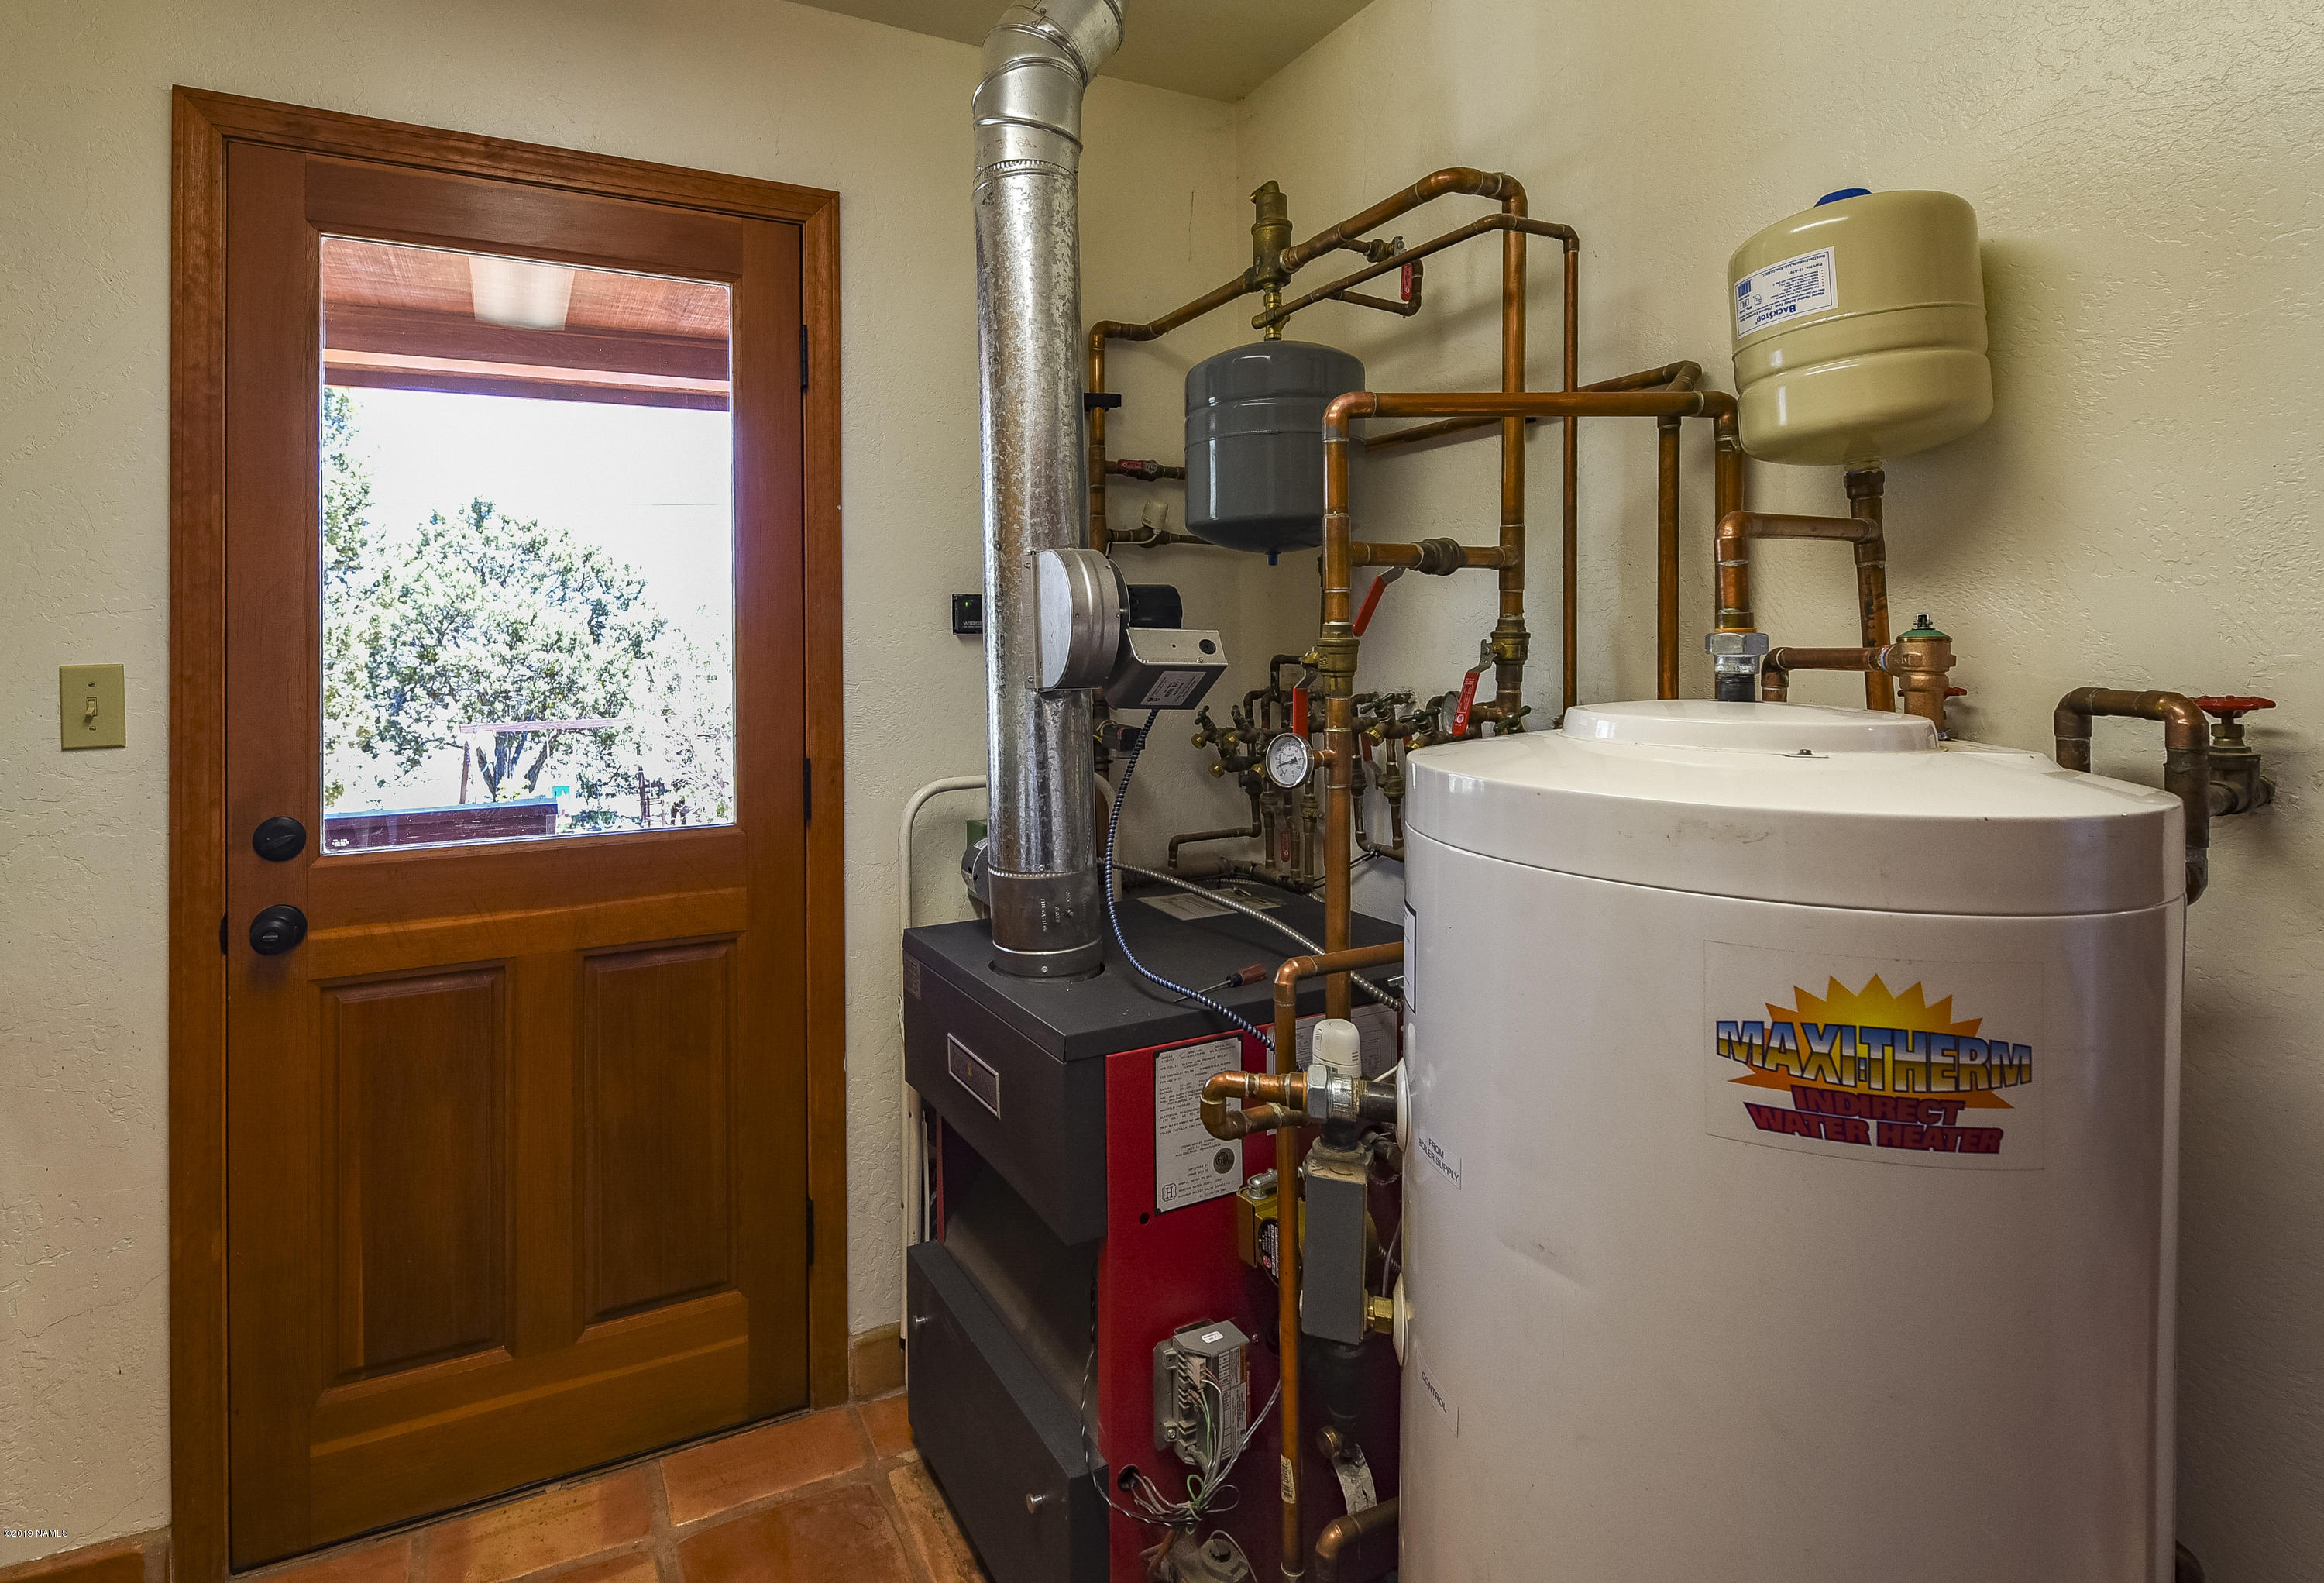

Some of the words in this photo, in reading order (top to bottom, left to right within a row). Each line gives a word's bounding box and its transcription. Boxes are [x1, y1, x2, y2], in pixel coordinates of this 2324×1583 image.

[1790, 1084, 1965, 1126] INDIRECT
[1428, 1137, 1445, 1159] FROM
[1743, 1101, 1872, 1146] WATER
[1876, 1120, 2004, 1154] HEATER
[1418, 1137, 1435, 1163] BOILER
[1435, 1158, 1459, 1182] SUPPLY
[1166, 1186, 1173, 1199] H
